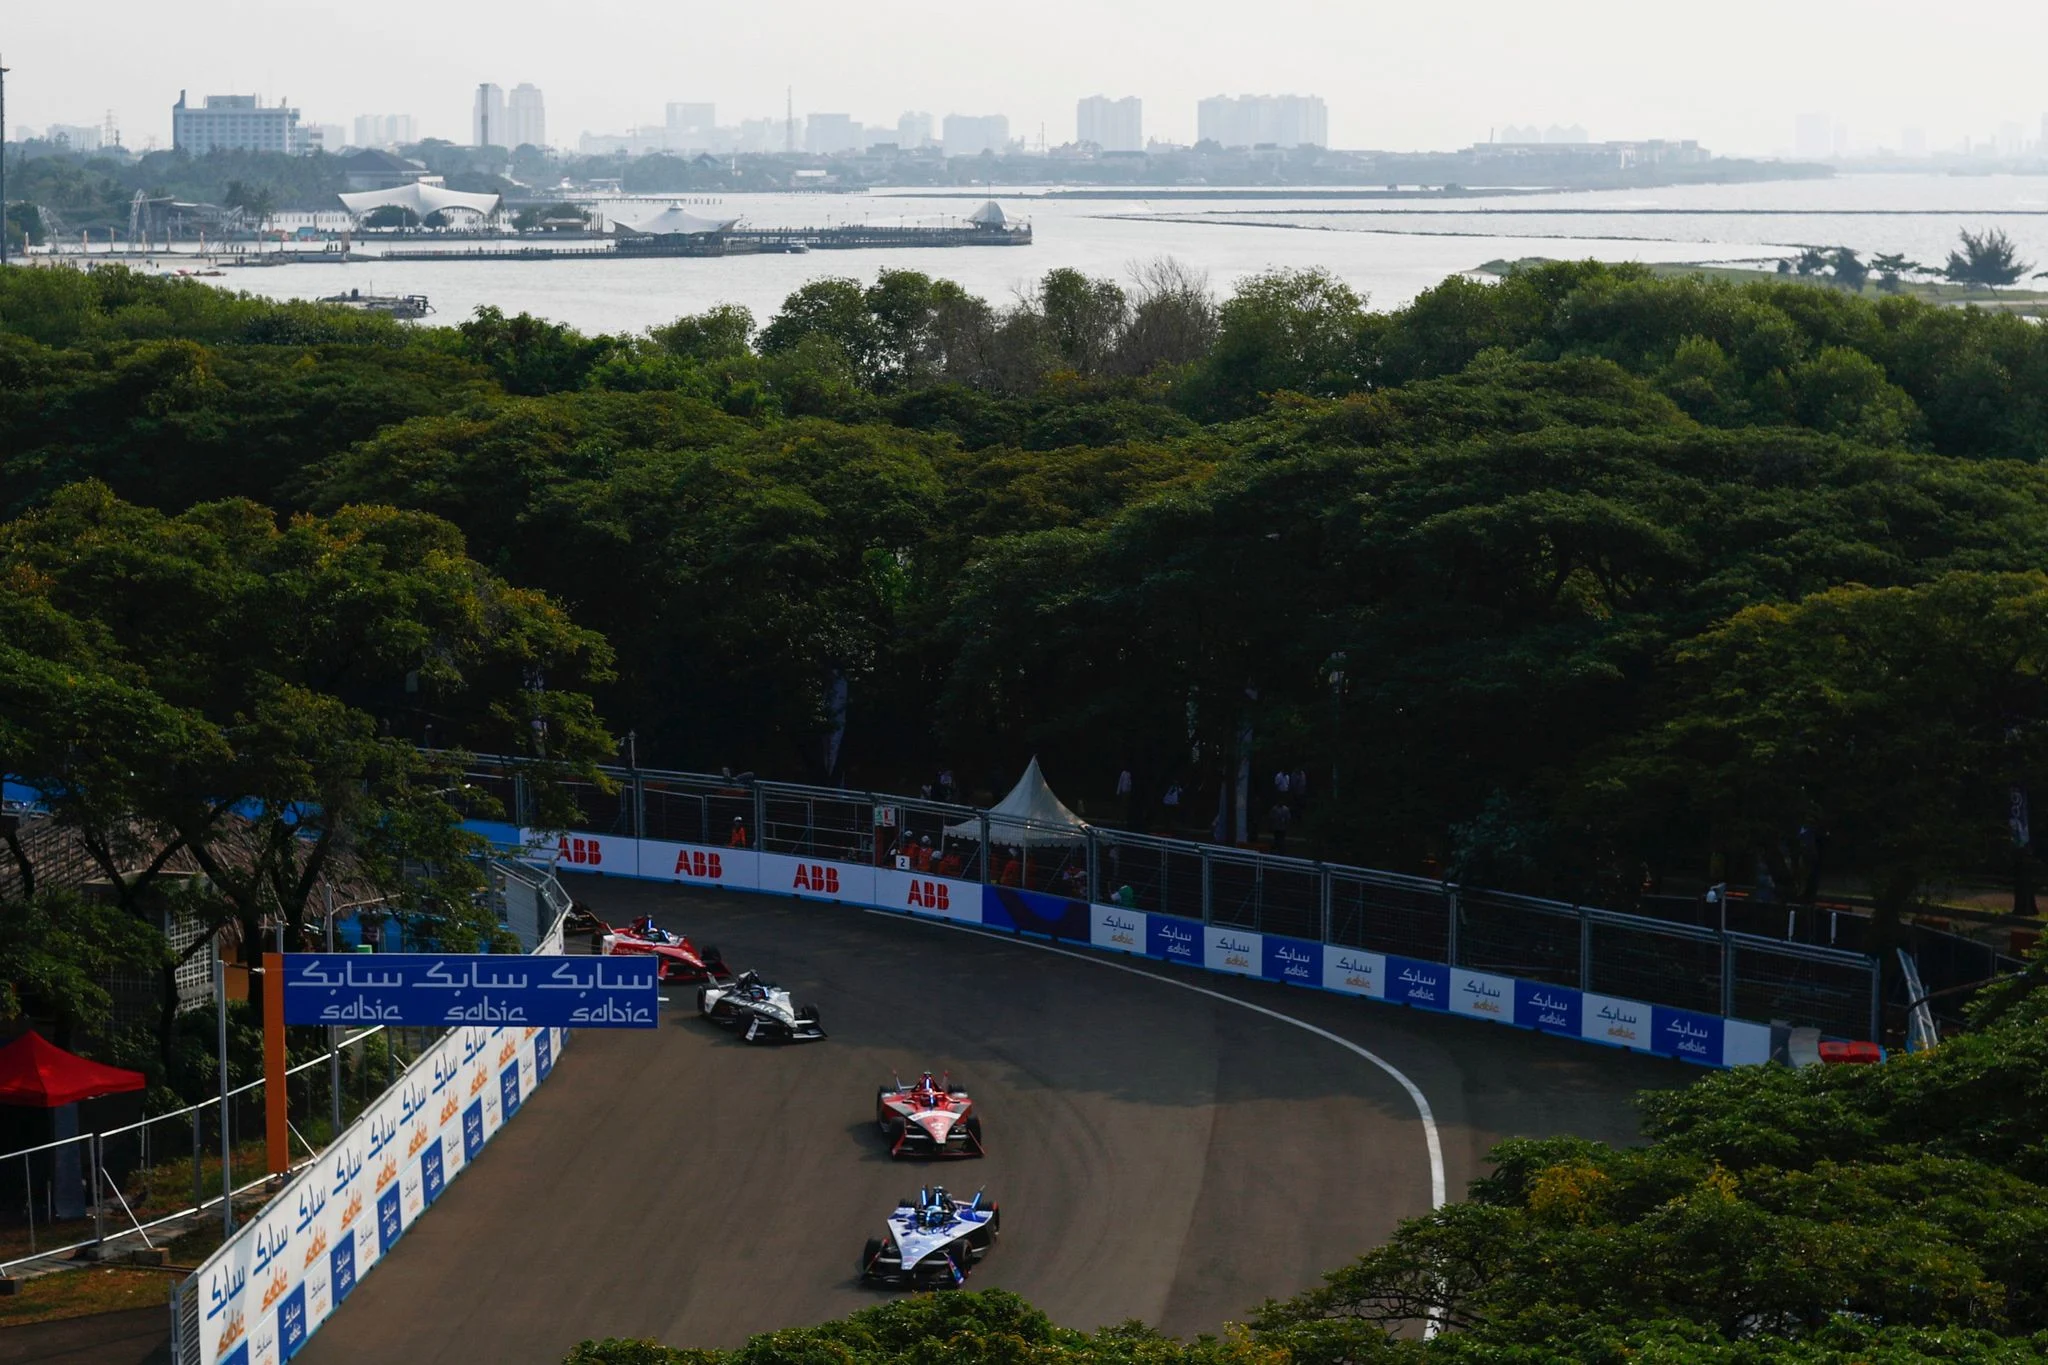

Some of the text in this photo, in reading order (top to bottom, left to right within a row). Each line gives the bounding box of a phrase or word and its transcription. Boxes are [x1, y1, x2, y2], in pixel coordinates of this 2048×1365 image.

[558, 836, 602, 865] ABB
[675, 850, 722, 878] ABB
[793, 863, 839, 894] ABB
[907, 879, 949, 910] ABB
[320, 995, 403, 1020] sabic
[444, 996, 528, 1021] sabic
[569, 997, 652, 1023] sabic
